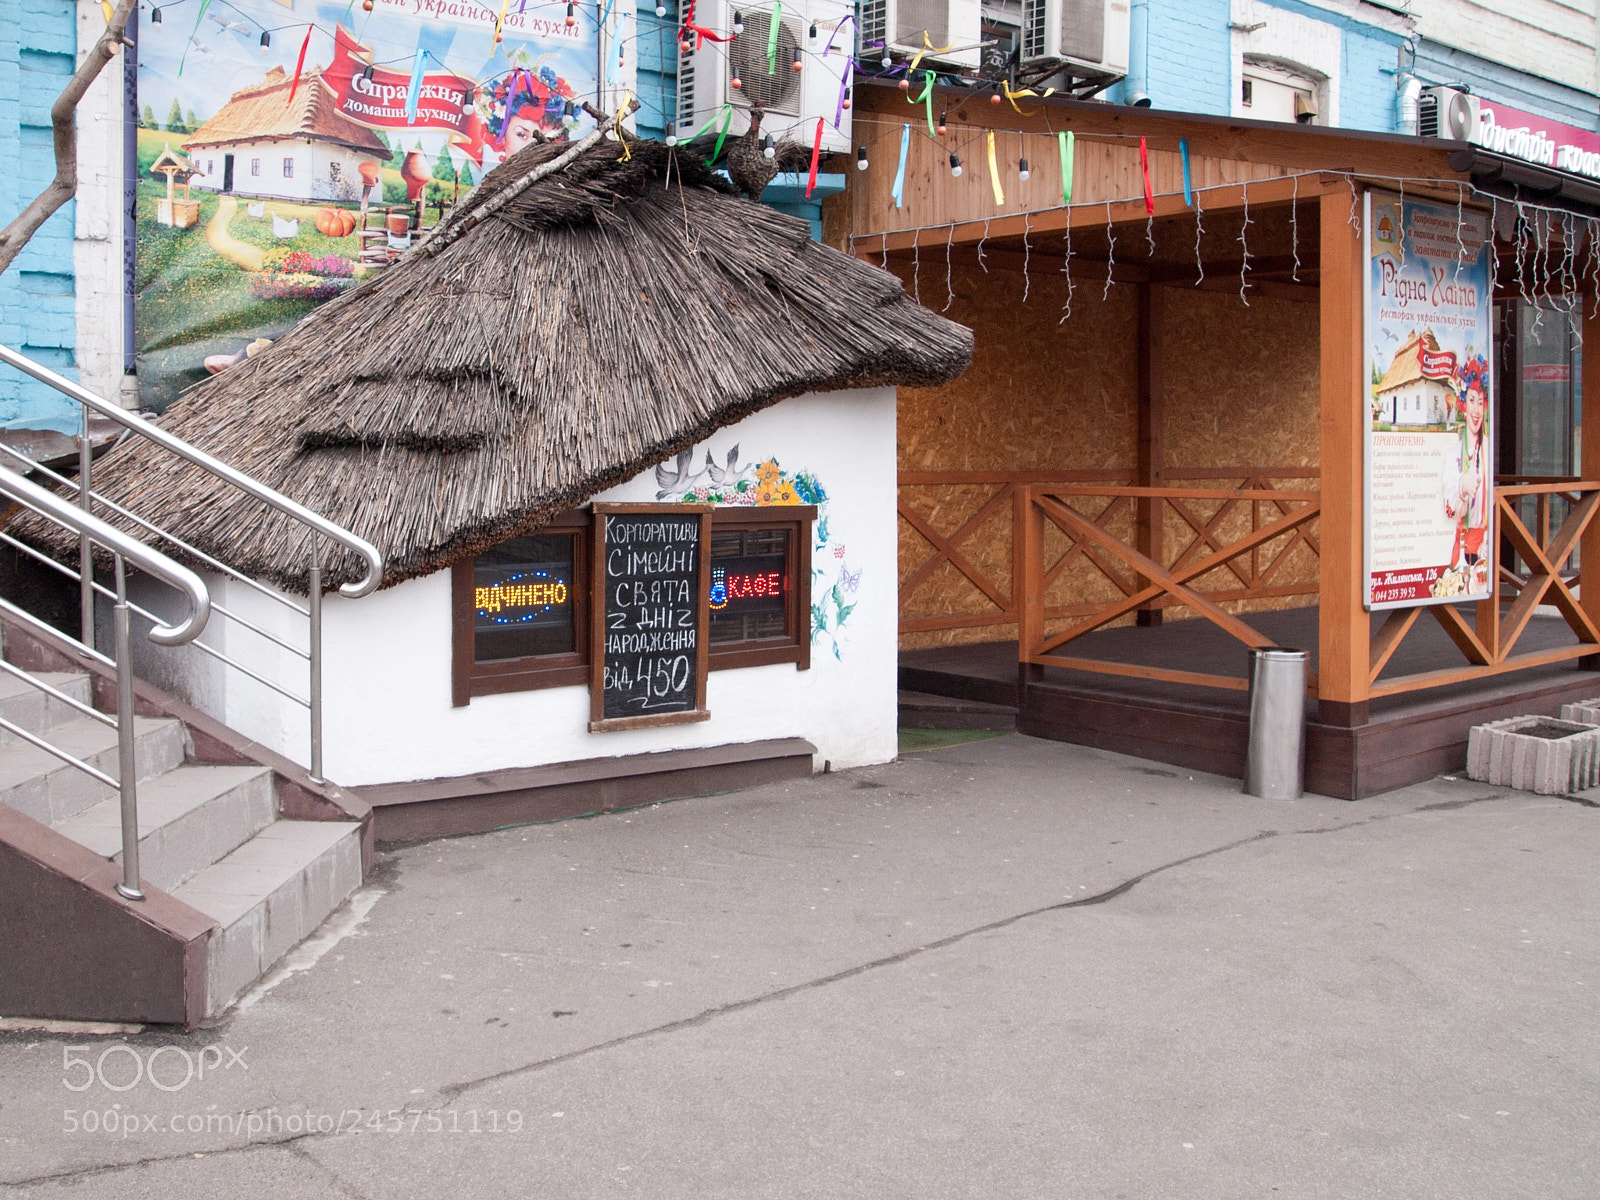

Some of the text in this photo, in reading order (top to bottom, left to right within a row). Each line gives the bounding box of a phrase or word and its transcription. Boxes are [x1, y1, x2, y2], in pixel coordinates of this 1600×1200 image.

[533, 17, 580, 38] кухні
[351, 73, 464, 106] Спражня
[343, 98, 463, 126] домашн кухня!
[1380, 258, 1427, 308] Рідна
[1380, 308, 1415, 323] ресторан
[1416, 312, 1458, 326] української
[728, 573, 780, 599] КАФЕ
[1425, 568, 1438, 581] 126
[475, 583, 567, 613] ВІДЧИНЕНО
[1375, 586, 1416, 601] 044 235 39 52
[637, 655, 690, 698] 450
